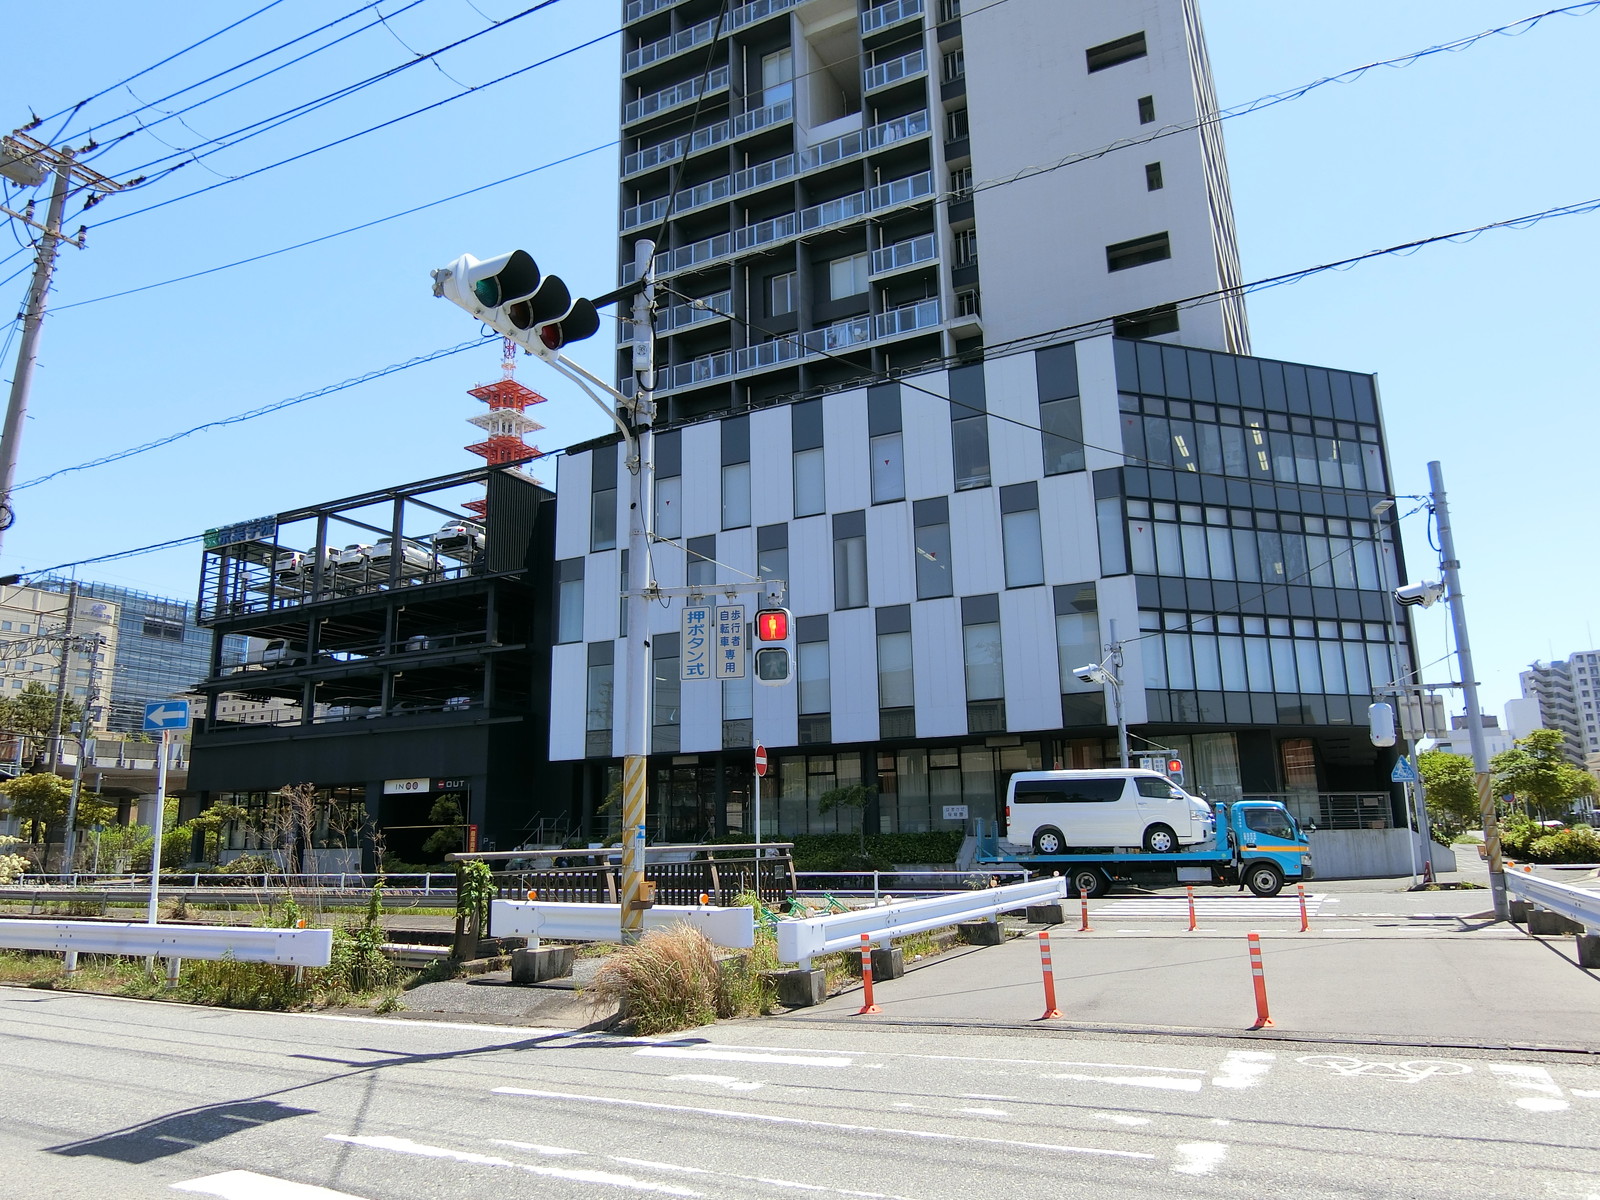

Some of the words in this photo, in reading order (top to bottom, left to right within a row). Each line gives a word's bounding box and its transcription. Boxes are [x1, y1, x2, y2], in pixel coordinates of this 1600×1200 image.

[686, 610, 705, 676] 押ボタン式
[720, 610, 730, 647] 自転車
[731, 610, 741, 647] 歩行者
[724, 649, 735, 673] 専用
[446, 780, 464, 788] OUT
